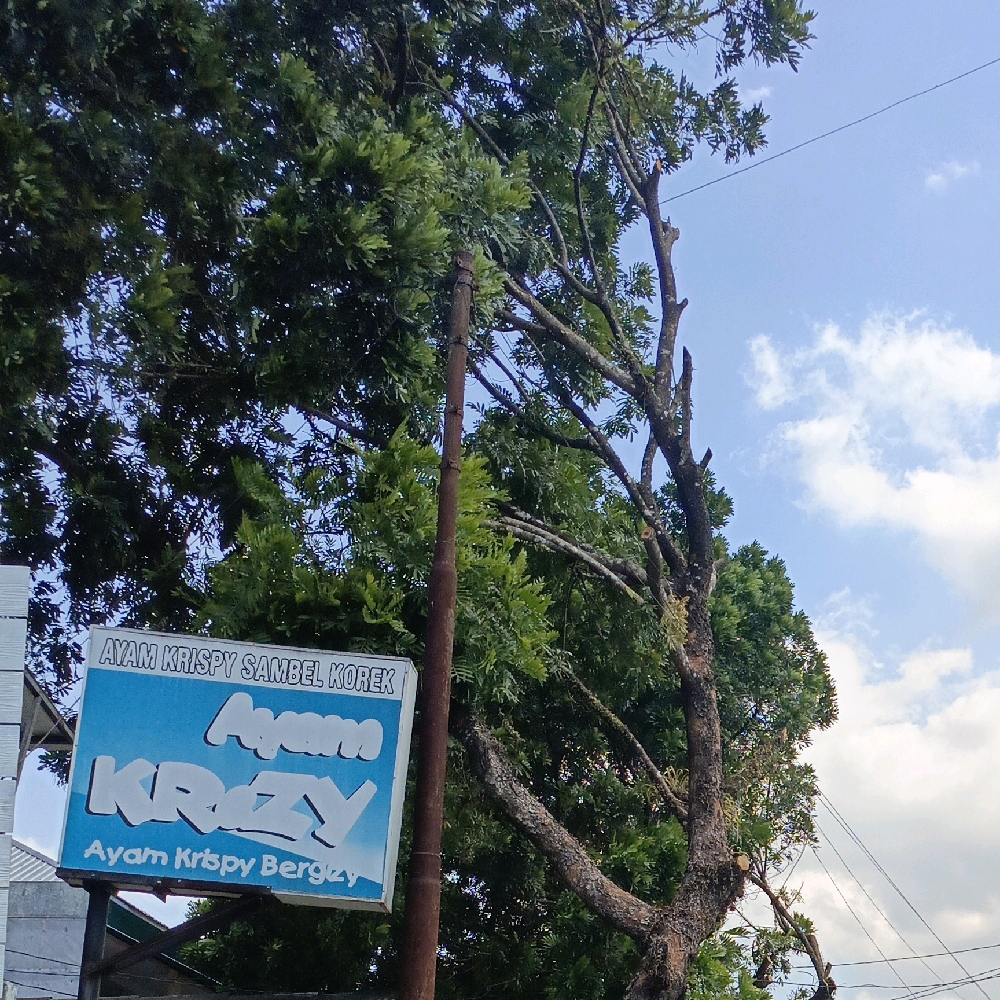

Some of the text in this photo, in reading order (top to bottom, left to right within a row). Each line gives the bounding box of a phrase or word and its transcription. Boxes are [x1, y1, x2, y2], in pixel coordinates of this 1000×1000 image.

[99, 638, 396, 694] AYAM KRISPY SAMBEL KOREK
[84, 840, 168, 867] Ayam
[174, 847, 256, 877] Krispy
